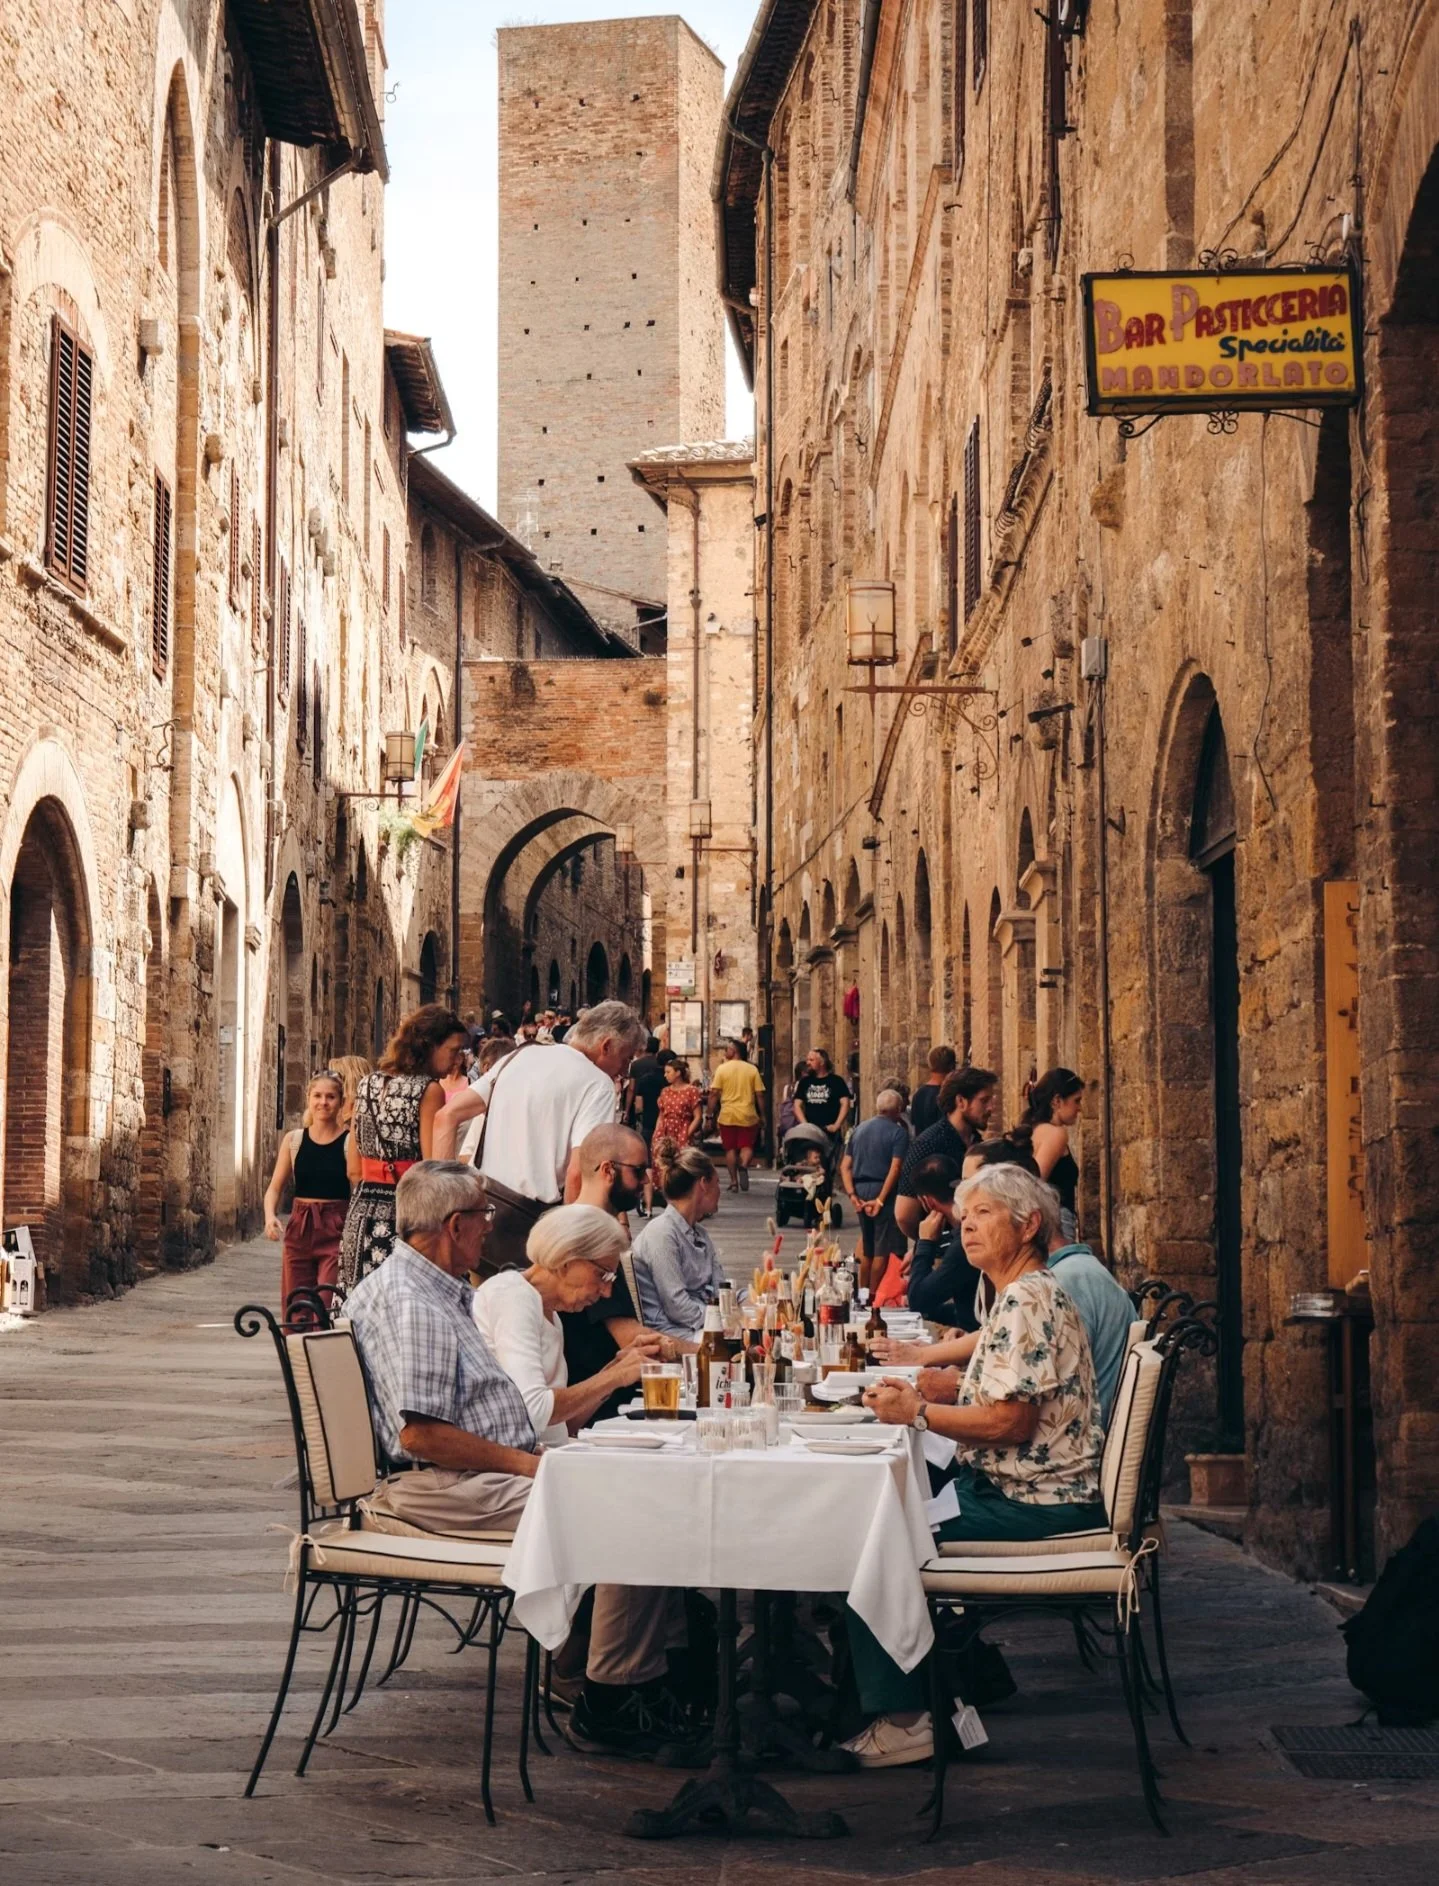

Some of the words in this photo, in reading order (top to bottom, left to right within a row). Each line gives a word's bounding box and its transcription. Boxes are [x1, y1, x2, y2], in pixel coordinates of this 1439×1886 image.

[1095, 299, 1165, 354] BAR
[1171, 284, 1347, 341] PASTICCERIA
[1219, 327, 1345, 361] Specialità
[1102, 361, 1348, 391] MANDORLATO
